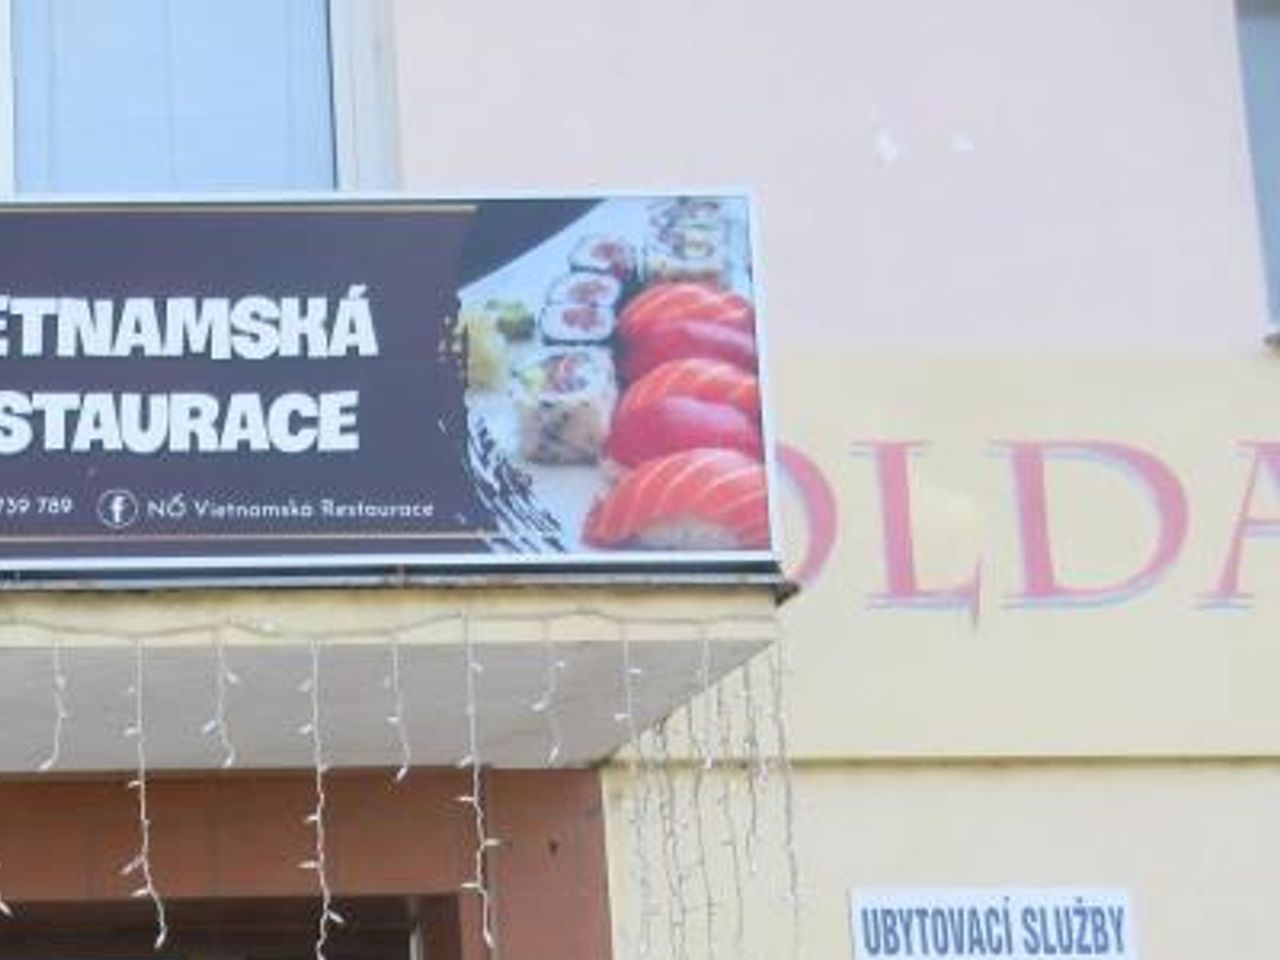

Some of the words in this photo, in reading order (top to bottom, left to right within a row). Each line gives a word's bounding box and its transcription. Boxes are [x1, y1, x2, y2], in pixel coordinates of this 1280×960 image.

[322, 496, 436, 518] Restaurace
[861, 896, 1013, 955] UBYTOVACÍ
[1022, 896, 1125, 954] SLUŽBY
